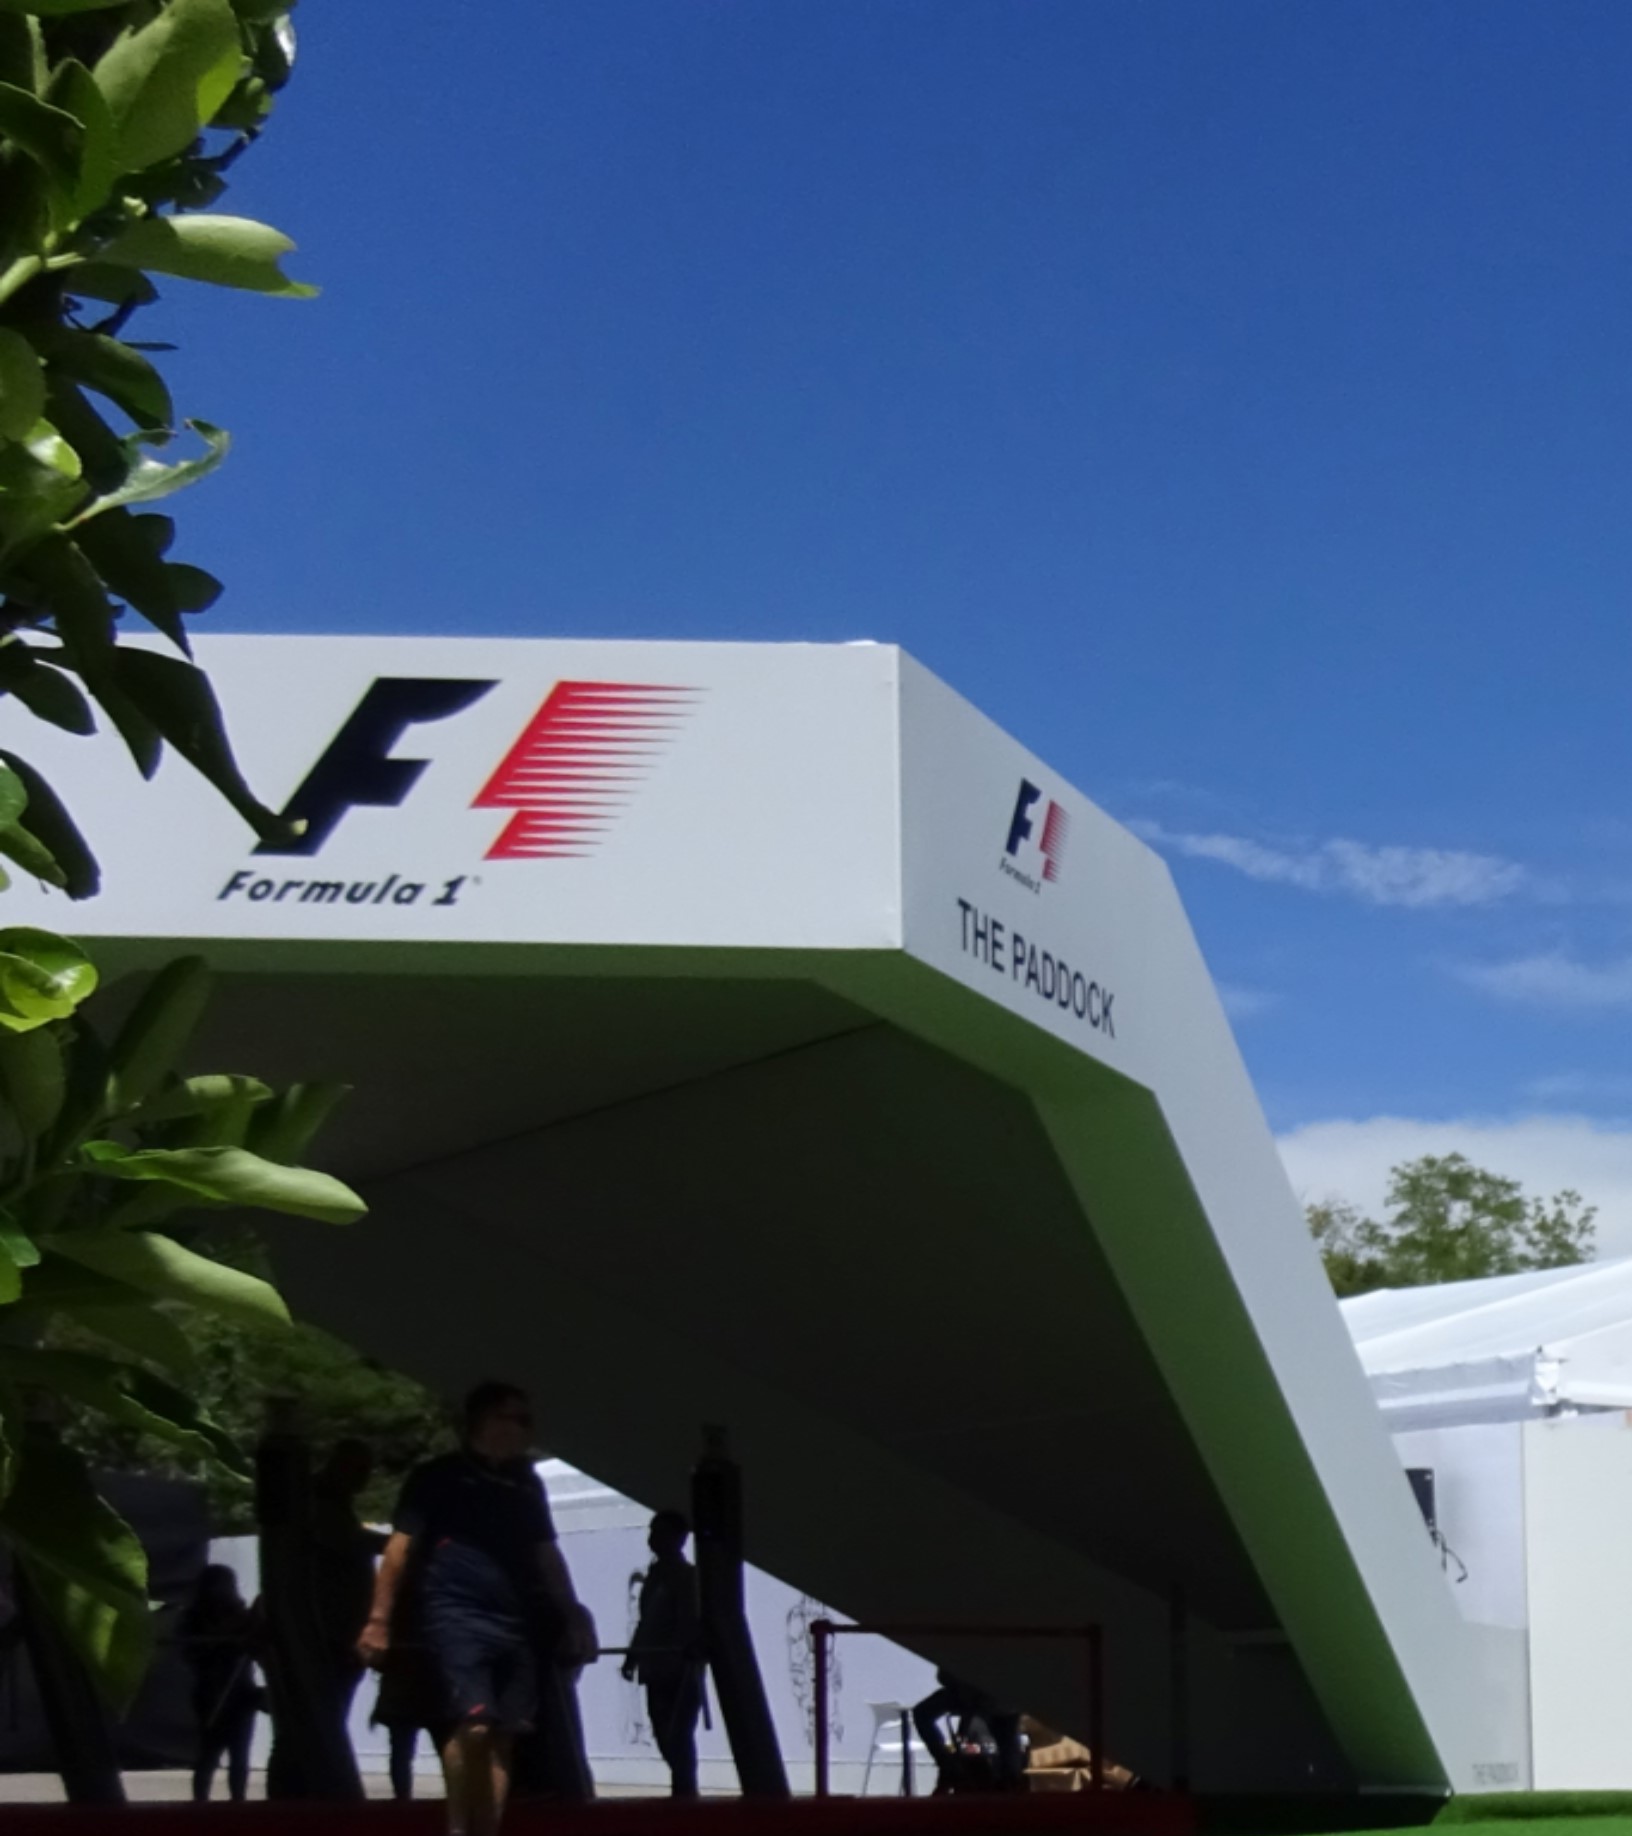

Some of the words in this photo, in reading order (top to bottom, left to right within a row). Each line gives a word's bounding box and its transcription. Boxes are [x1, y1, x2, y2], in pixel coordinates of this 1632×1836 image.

[216, 871, 425, 906] Formula
[957, 896, 1005, 974] THE
[1012, 932, 1116, 1040] PADDOCK
